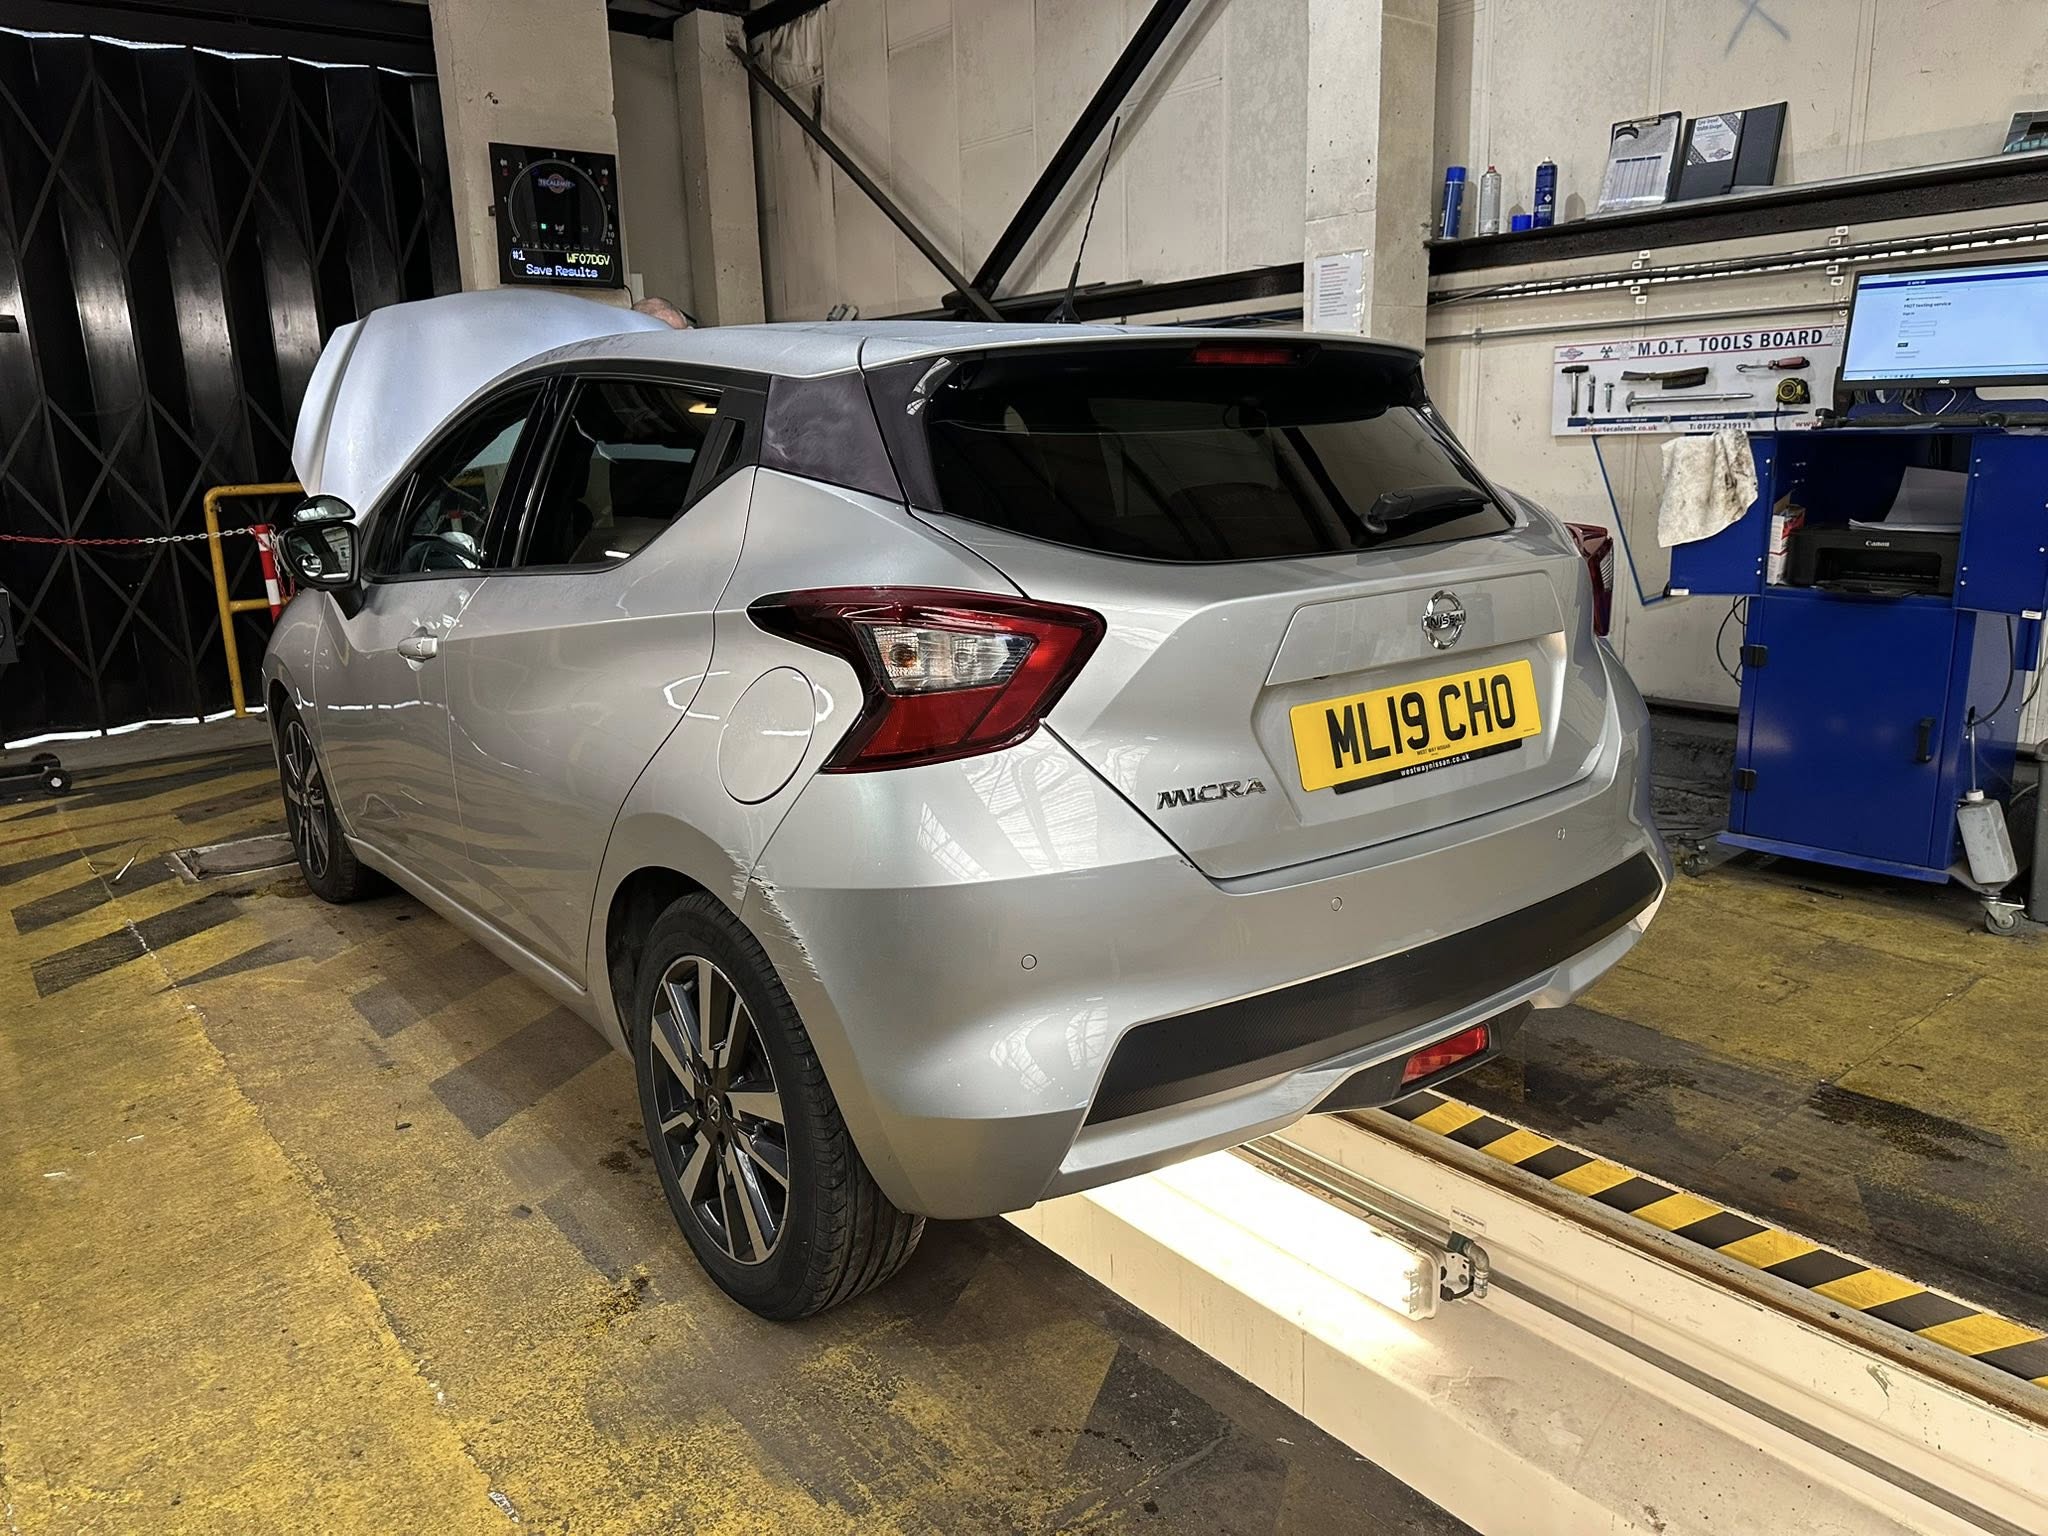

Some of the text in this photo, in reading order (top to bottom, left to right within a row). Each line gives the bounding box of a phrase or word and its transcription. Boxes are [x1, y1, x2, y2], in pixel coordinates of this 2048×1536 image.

[566, 252, 610, 266] WF07DGV
[525, 263, 599, 278] Save Results
[1637, 329, 1823, 356] M.O.T. TOOLS BOARD
[1430, 613, 1466, 627] NISSAN
[1325, 673, 1517, 769] ML19 CHO
[1400, 754, 1471, 776] westwaynissan.co.uk
[1156, 777, 1267, 810] MICRA
